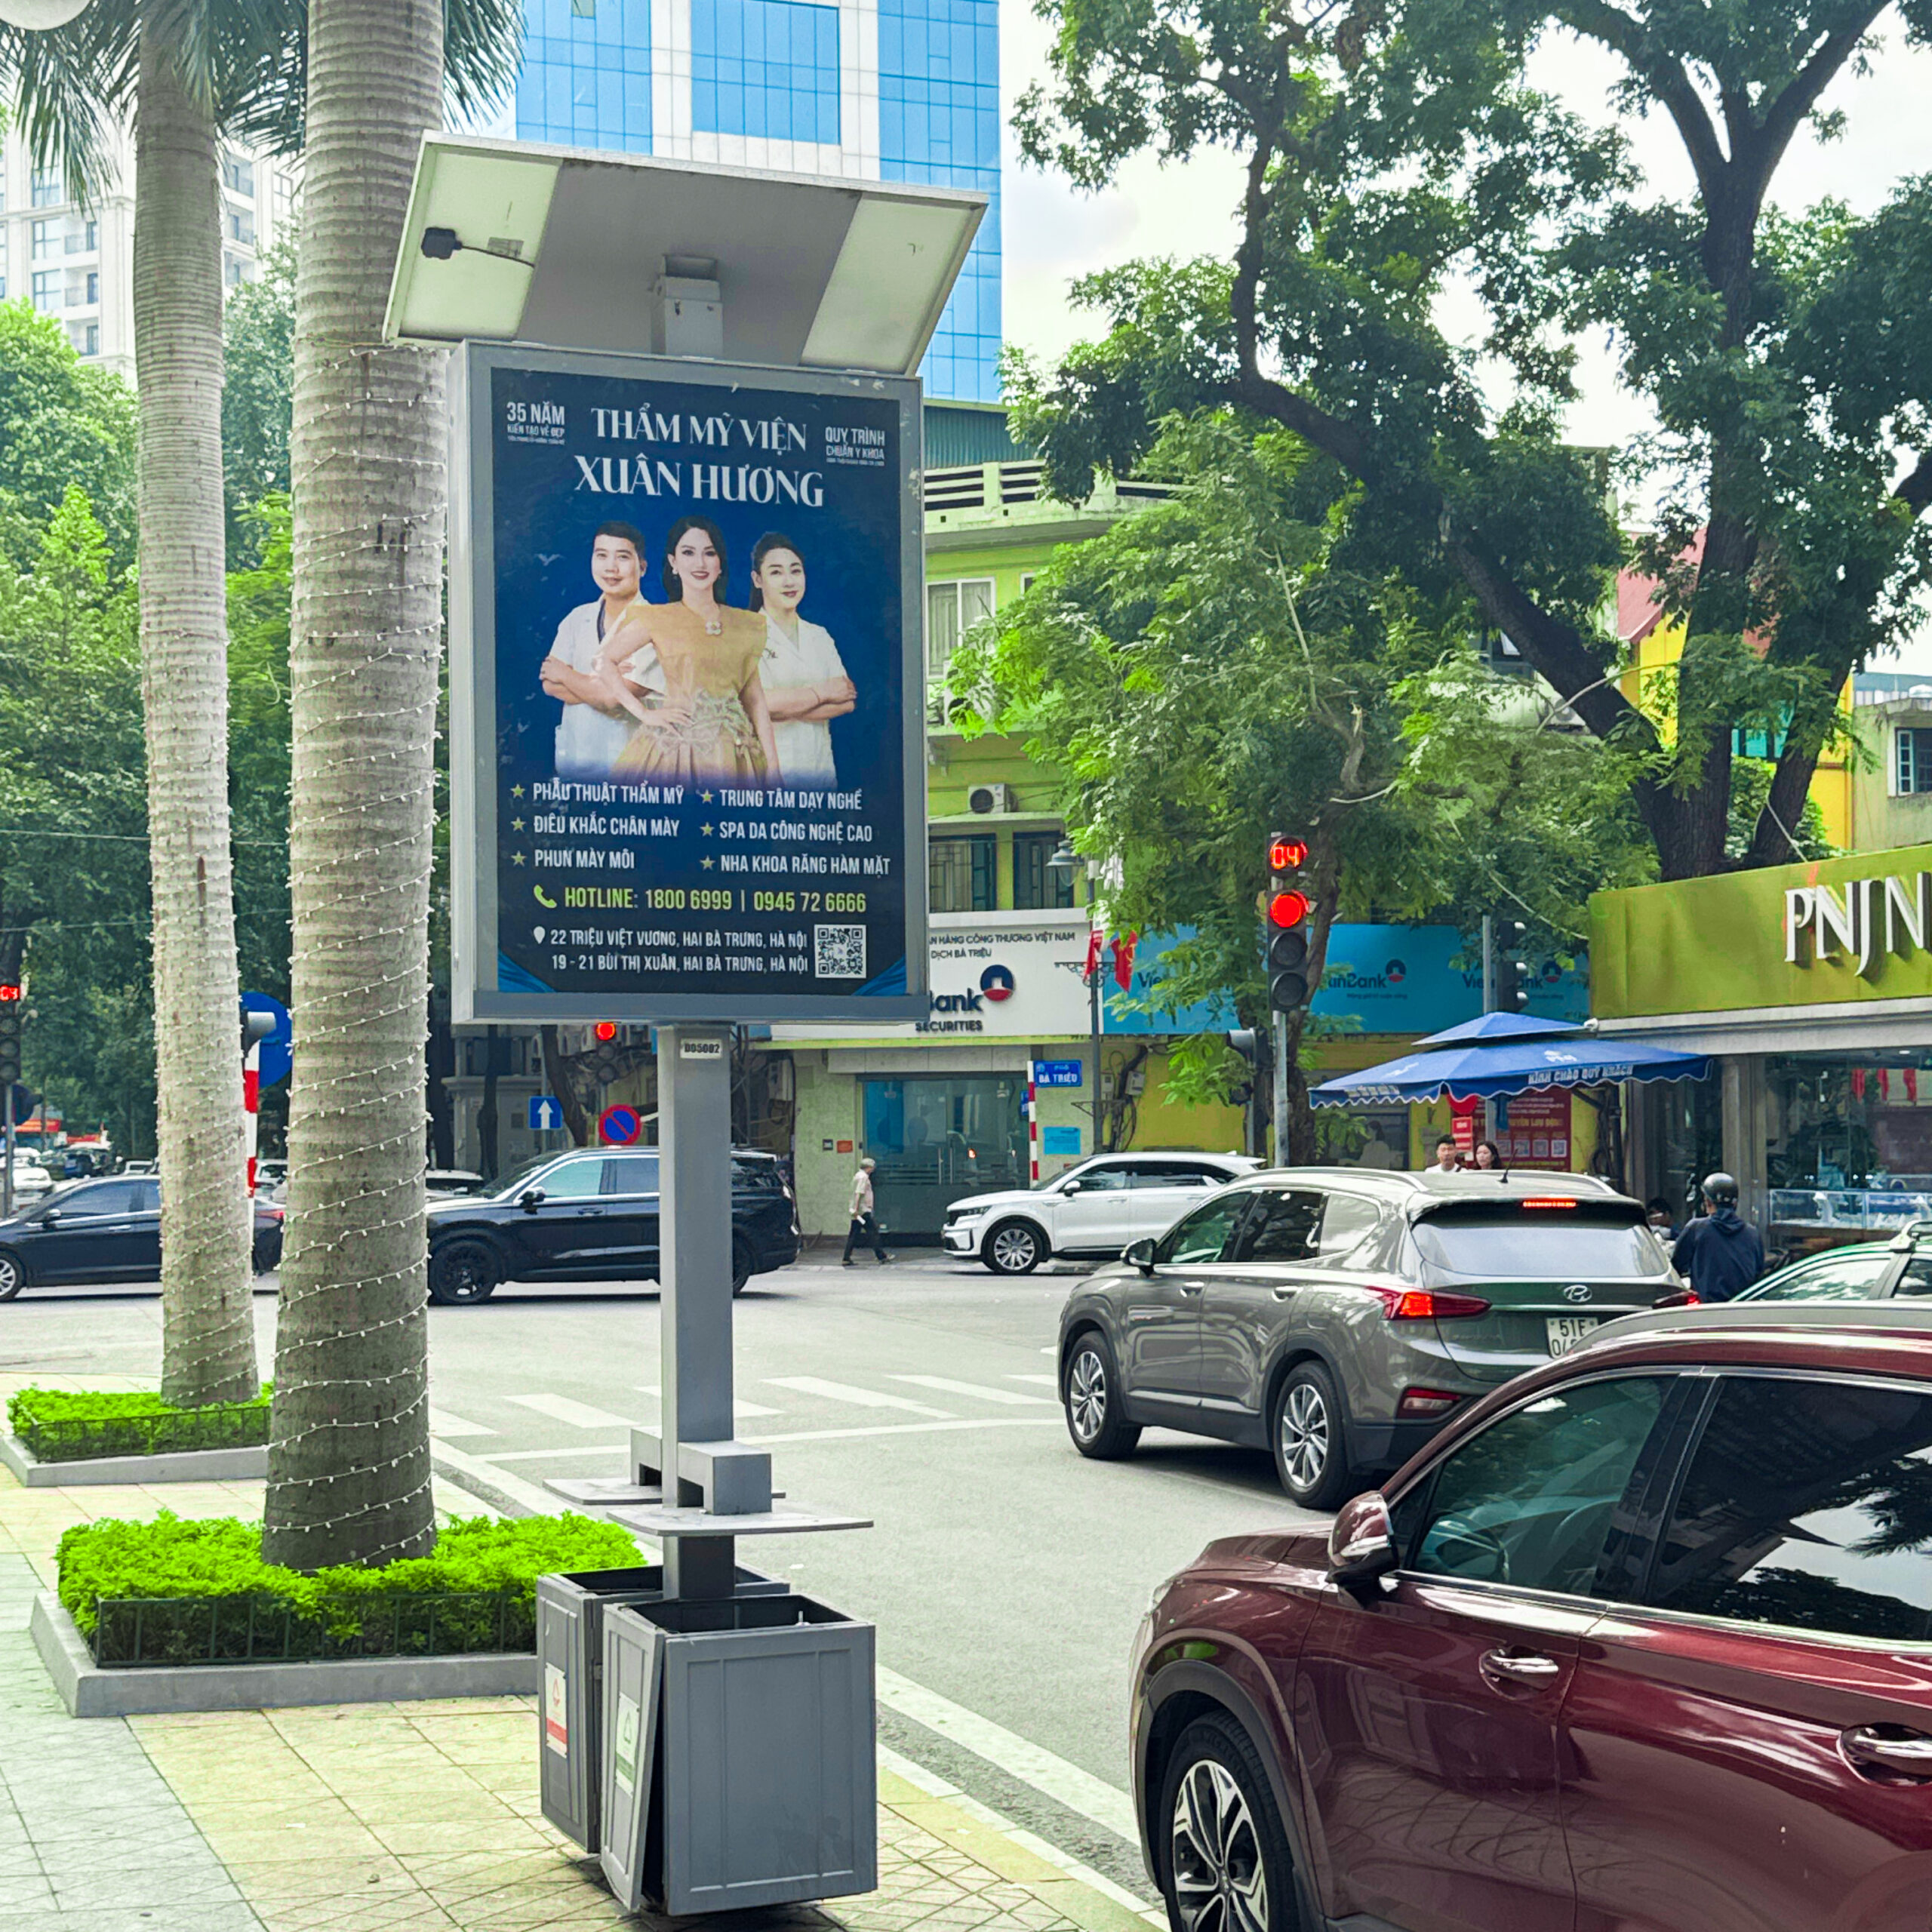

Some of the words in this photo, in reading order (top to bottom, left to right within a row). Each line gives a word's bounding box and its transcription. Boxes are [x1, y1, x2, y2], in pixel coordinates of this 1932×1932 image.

[506, 401, 527, 423] 35
[531, 401, 565, 426] NĂM
[591, 402, 680, 443] THẨM
[690, 411, 734, 447] MỸ
[740, 415, 807, 456] VIỆN
[825, 426, 848, 443] QUY
[850, 426, 885, 446] TRÌNH
[854, 448, 862, 458] Y
[574, 452, 681, 497] XUÂN
[692, 463, 824, 507] HƯƠNG
[574, 782, 617, 805] THUẬT
[620, 780, 660, 804] THẨM
[663, 785, 684, 804] MỸ
[719, 789, 763, 808] TRUNG
[767, 787, 795, 808] TÂM
[799, 791, 824, 813] DẠY
[827, 788, 863, 810] NGHỀ
[569, 811, 606, 835] KHẮC
[610, 815, 648, 835] CHÂN
[651, 817, 680, 836] MÀY
[719, 821, 746, 839] SPA
[749, 822, 767, 839] DA
[770, 820, 805, 841] CÔNG
[809, 821, 844, 845] NGHỆ
[847, 825, 872, 842] CAO
[534, 849, 572, 867] PHUN
[576, 847, 605, 868] MÀY
[609, 848, 635, 869] MÔI
[721, 854, 749, 872] NHA
[752, 855, 788, 873] KHOA
[792, 854, 827, 874] RĂNG
[831, 854, 860, 875] HÀM
[863, 855, 891, 878] MẶT
[1272, 846, 1299, 868] 04
[565, 888, 638, 909] HOTLINE:
[645, 889, 685, 909] 1800
[689, 890, 732, 910] 6999
[754, 891, 795, 912] 0945
[800, 892, 820, 912] 72
[826, 893, 866, 913] 6666
[550, 929, 567, 945] 22
[570, 927, 603, 948] TRIỆU
[607, 928, 633, 949] VIỆT
[636, 930, 680, 948] VƯƠNG,
[683, 931, 703, 946] HAI
[706, 929, 721, 946] BÀ
[770, 930, 786, 948] HÀ
[789, 930, 808, 951] NỘI
[966, 933, 993, 943] CÔNG
[1054, 932, 1075, 942] NAM
[1785, 878, 1873, 977] PNJ
[552, 954, 567, 970] 19
[578, 955, 593, 970] 21
[598, 952, 618, 971] BÙI
[621, 955, 641, 974] THỊ
[644, 953, 681, 972] XUÂN,
[683, 956, 703, 971] HAI
[706, 954, 722, 972] BÀ
[770, 955, 786, 972] HÀ
[789, 956, 808, 974] NỘI
[915, 1020, 983, 1032] SECURITIES
